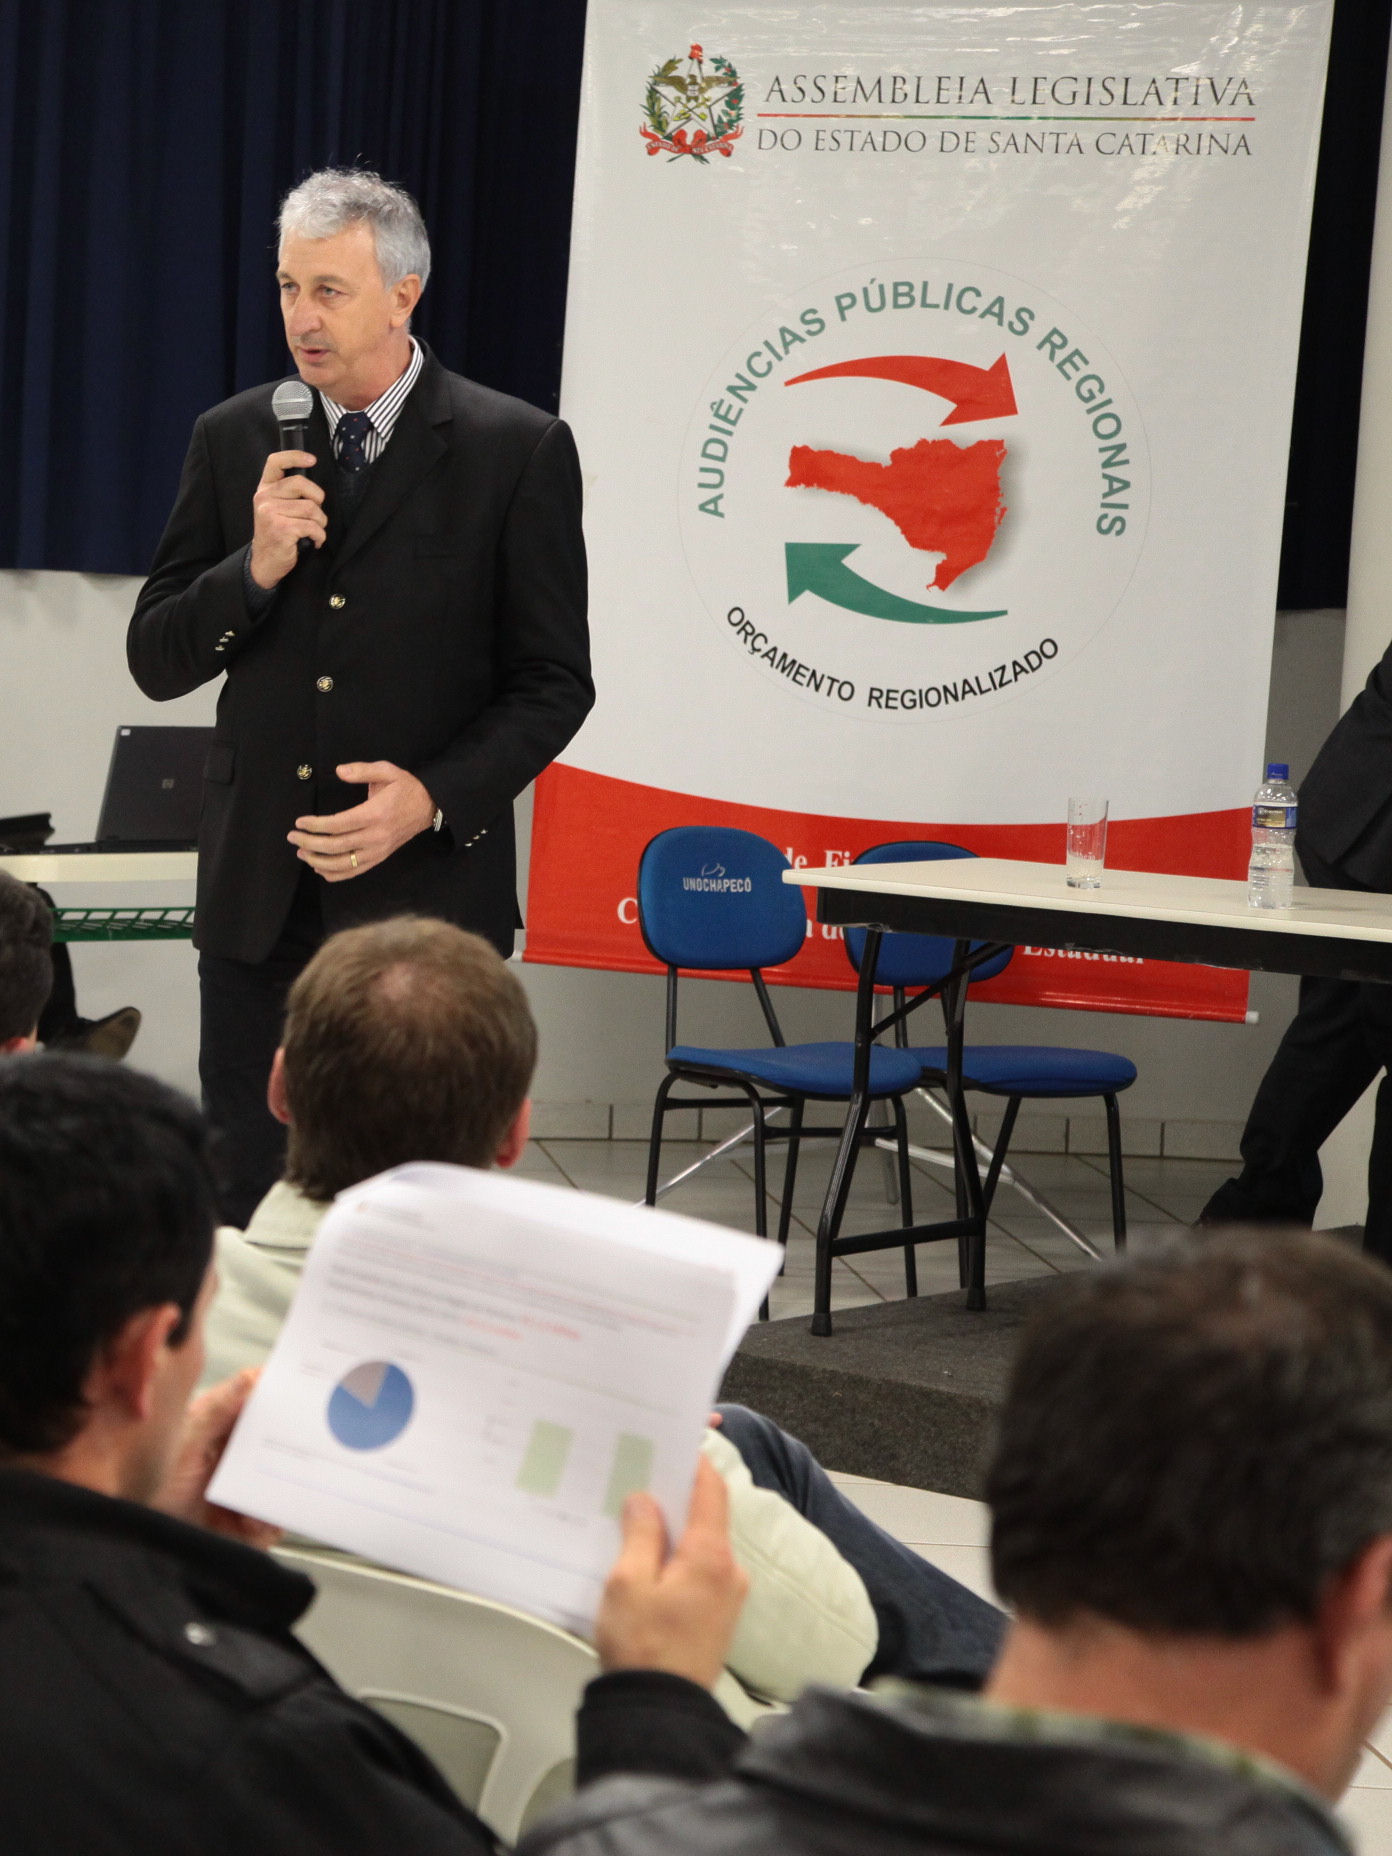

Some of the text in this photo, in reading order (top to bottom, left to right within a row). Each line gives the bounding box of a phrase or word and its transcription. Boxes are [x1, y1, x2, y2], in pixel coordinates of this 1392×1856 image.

[764, 74, 1257, 107] ASSEMBLEIA LEGISLATIVA
[757, 128, 803, 151] DO
[814, 129, 927, 153] ESTADO
[939, 130, 977, 154] DE
[988, 130, 1085, 155] SANTA
[1095, 132, 1253, 156] CATARINA
[697, 278, 1132, 538] AUDIÊNCIAS PÚBLICAS REGIONAIS
[726, 606, 1060, 711] ORÇAMENTO REGIONALIZADO
